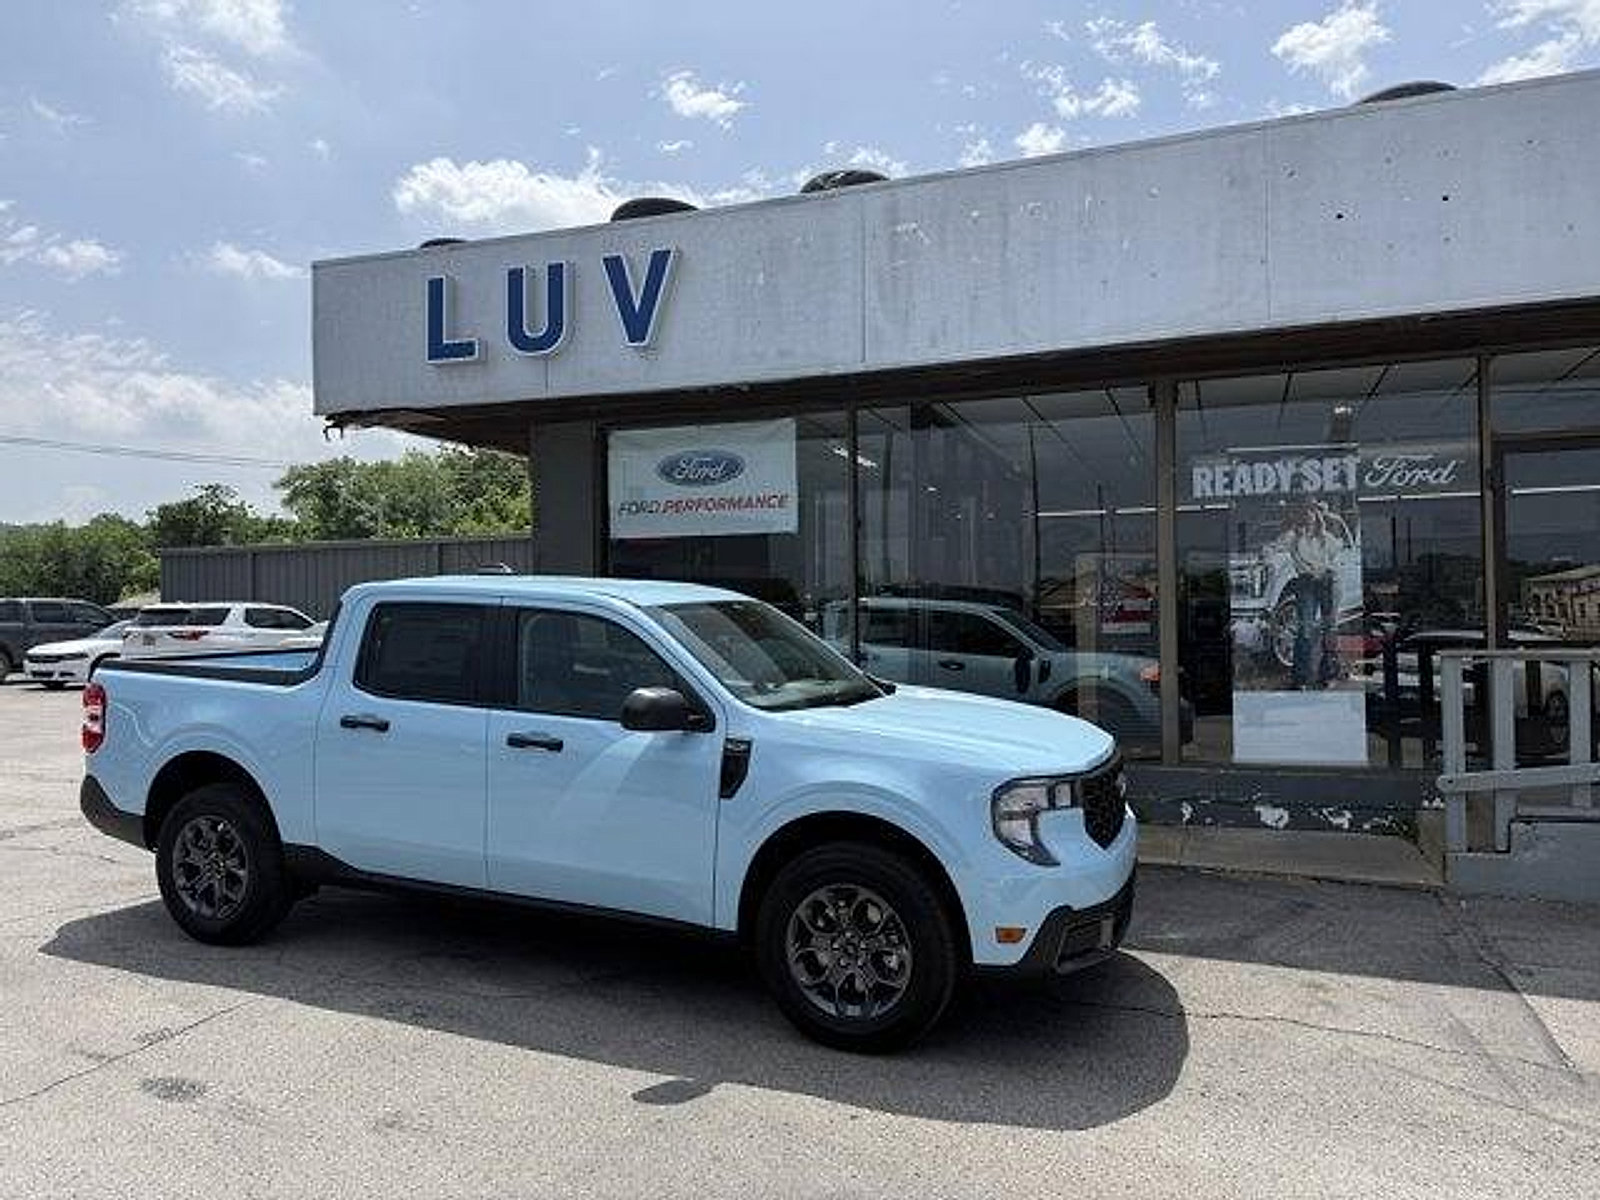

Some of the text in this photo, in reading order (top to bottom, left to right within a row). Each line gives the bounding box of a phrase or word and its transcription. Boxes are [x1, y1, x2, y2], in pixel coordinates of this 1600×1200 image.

[1192, 454, 1458, 497] READY SET Ford
[619, 492, 789, 515] FORD PERFORMANCE
